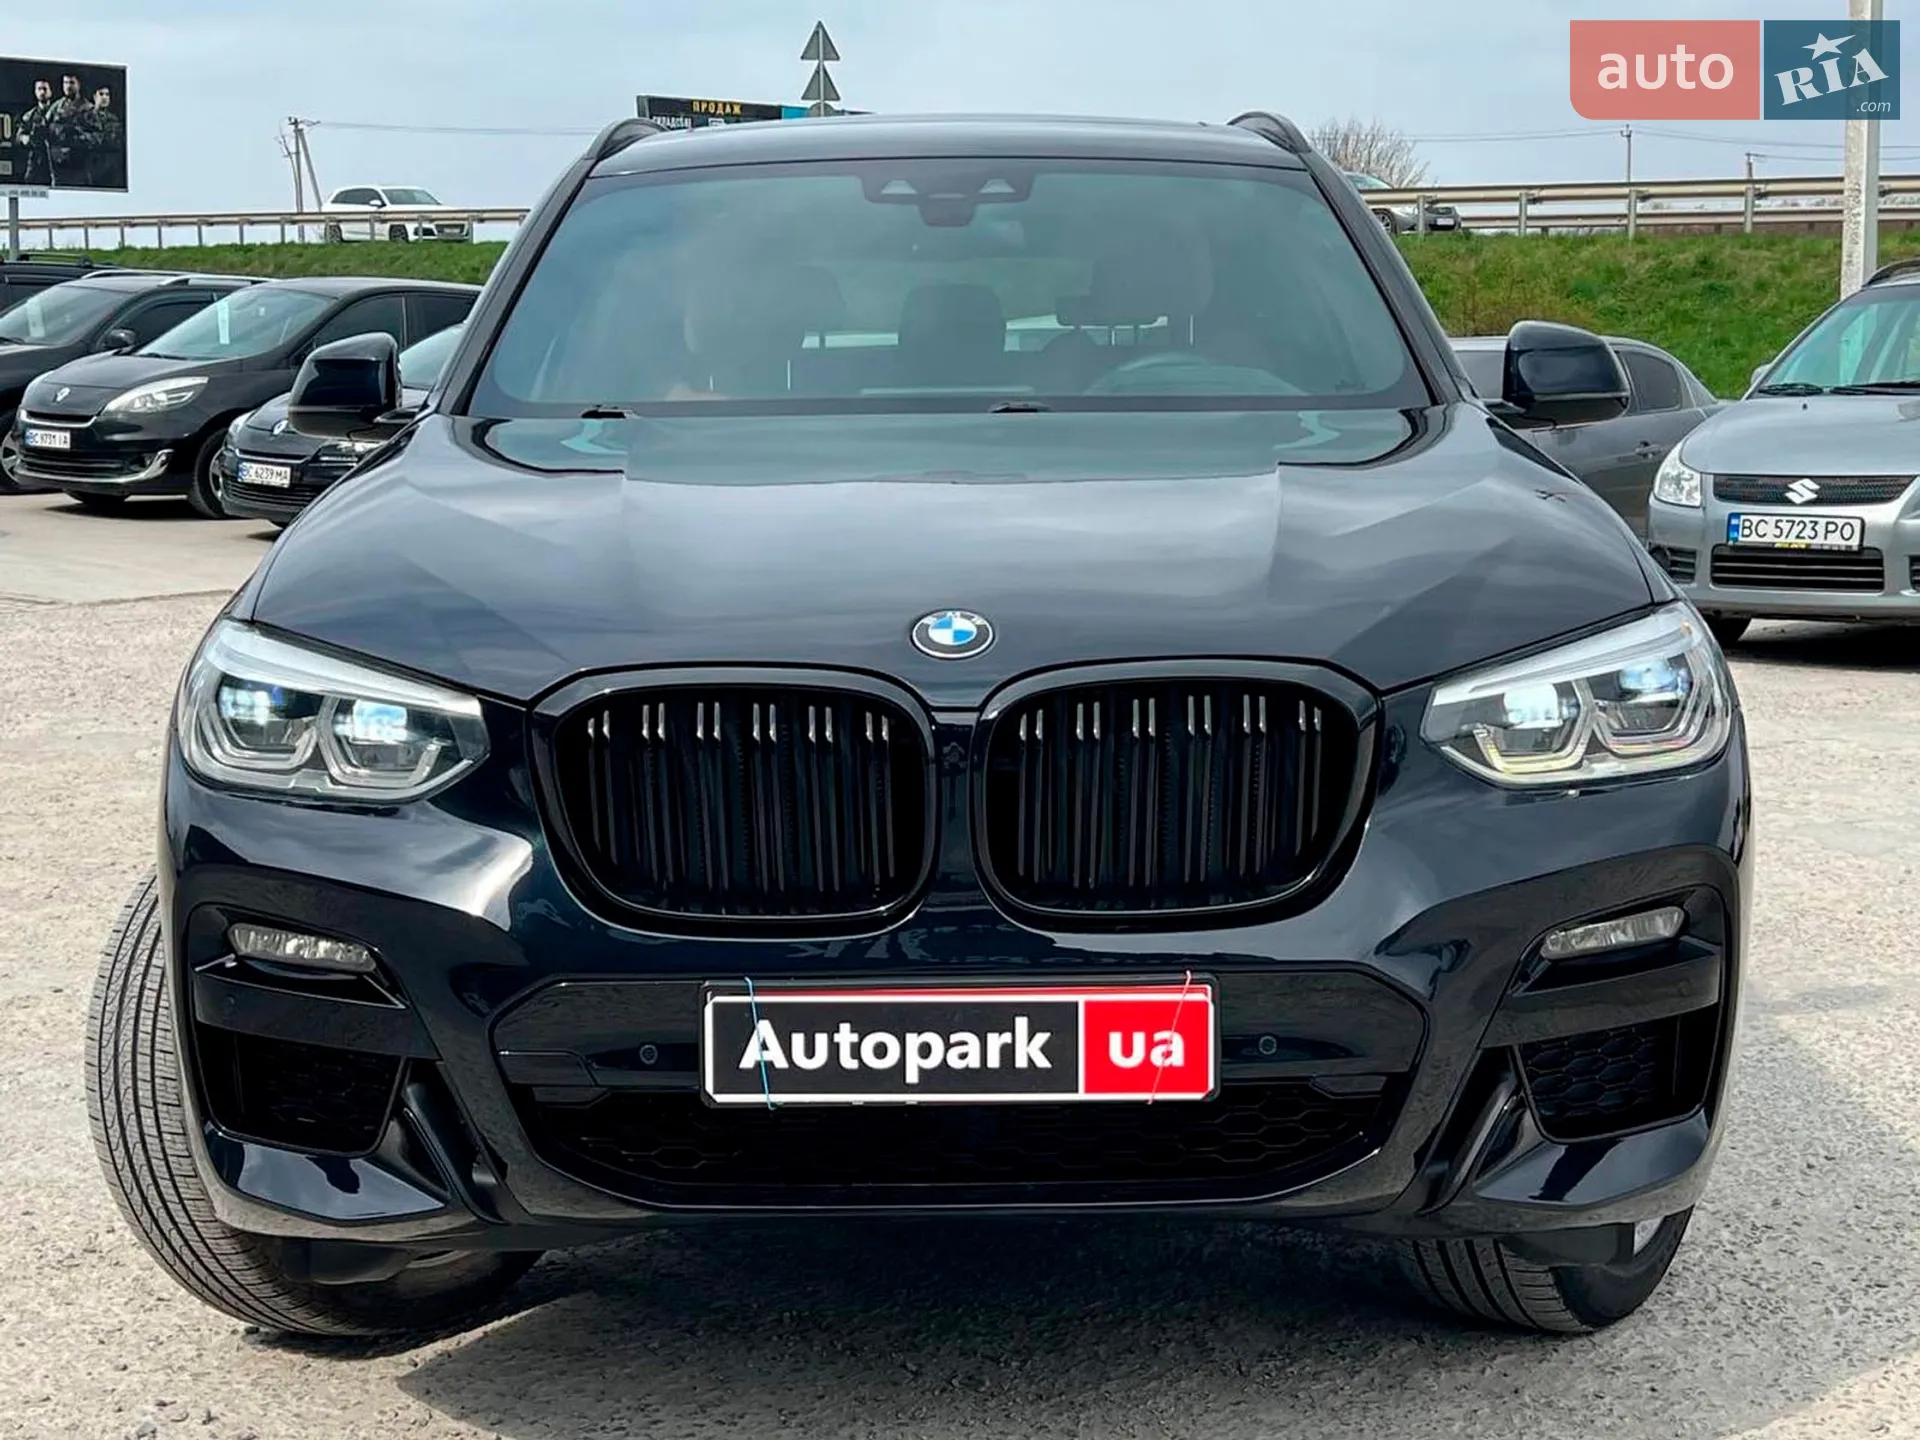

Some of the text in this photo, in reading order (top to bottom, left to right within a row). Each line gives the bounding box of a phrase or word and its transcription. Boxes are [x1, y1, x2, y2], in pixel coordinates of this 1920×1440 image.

[692, 101, 741, 115] ПРОДАЖ
[255, 467, 274, 480] 6239
[1741, 519, 1855, 541] BC 5723 PO
[739, 1016, 1185, 1085] Autopark ua
